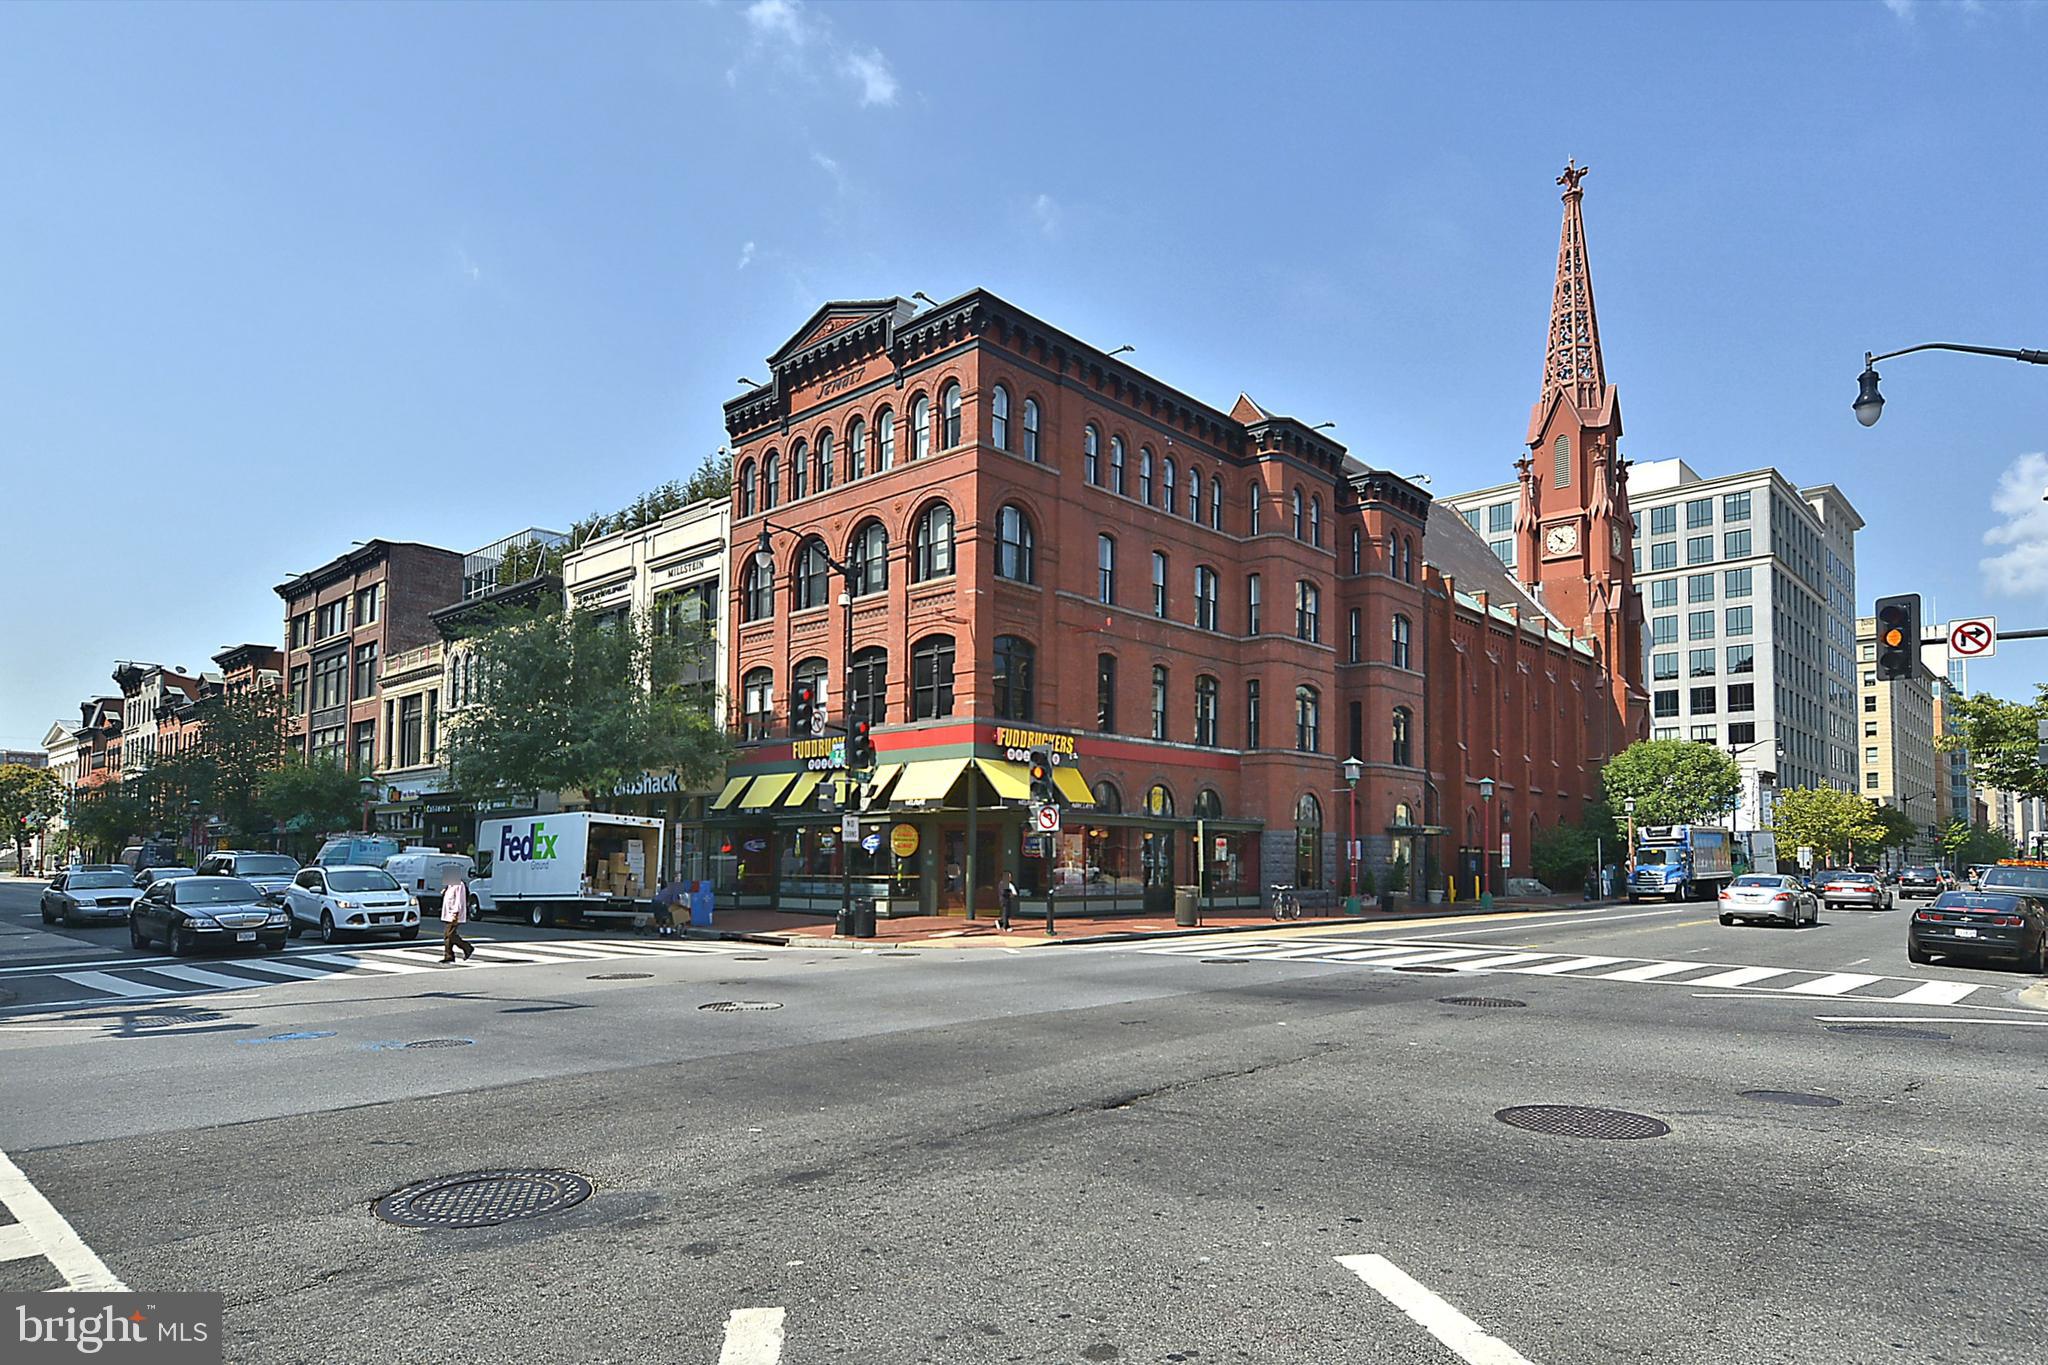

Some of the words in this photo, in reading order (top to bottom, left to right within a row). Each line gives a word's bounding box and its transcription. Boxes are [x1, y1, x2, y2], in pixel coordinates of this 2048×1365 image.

[667, 559, 704, 578] MILLSTEIN
[792, 736, 846, 760] FUDDRU
[847, 819, 855, 828] NO
[499, 822, 559, 862] FedEx
